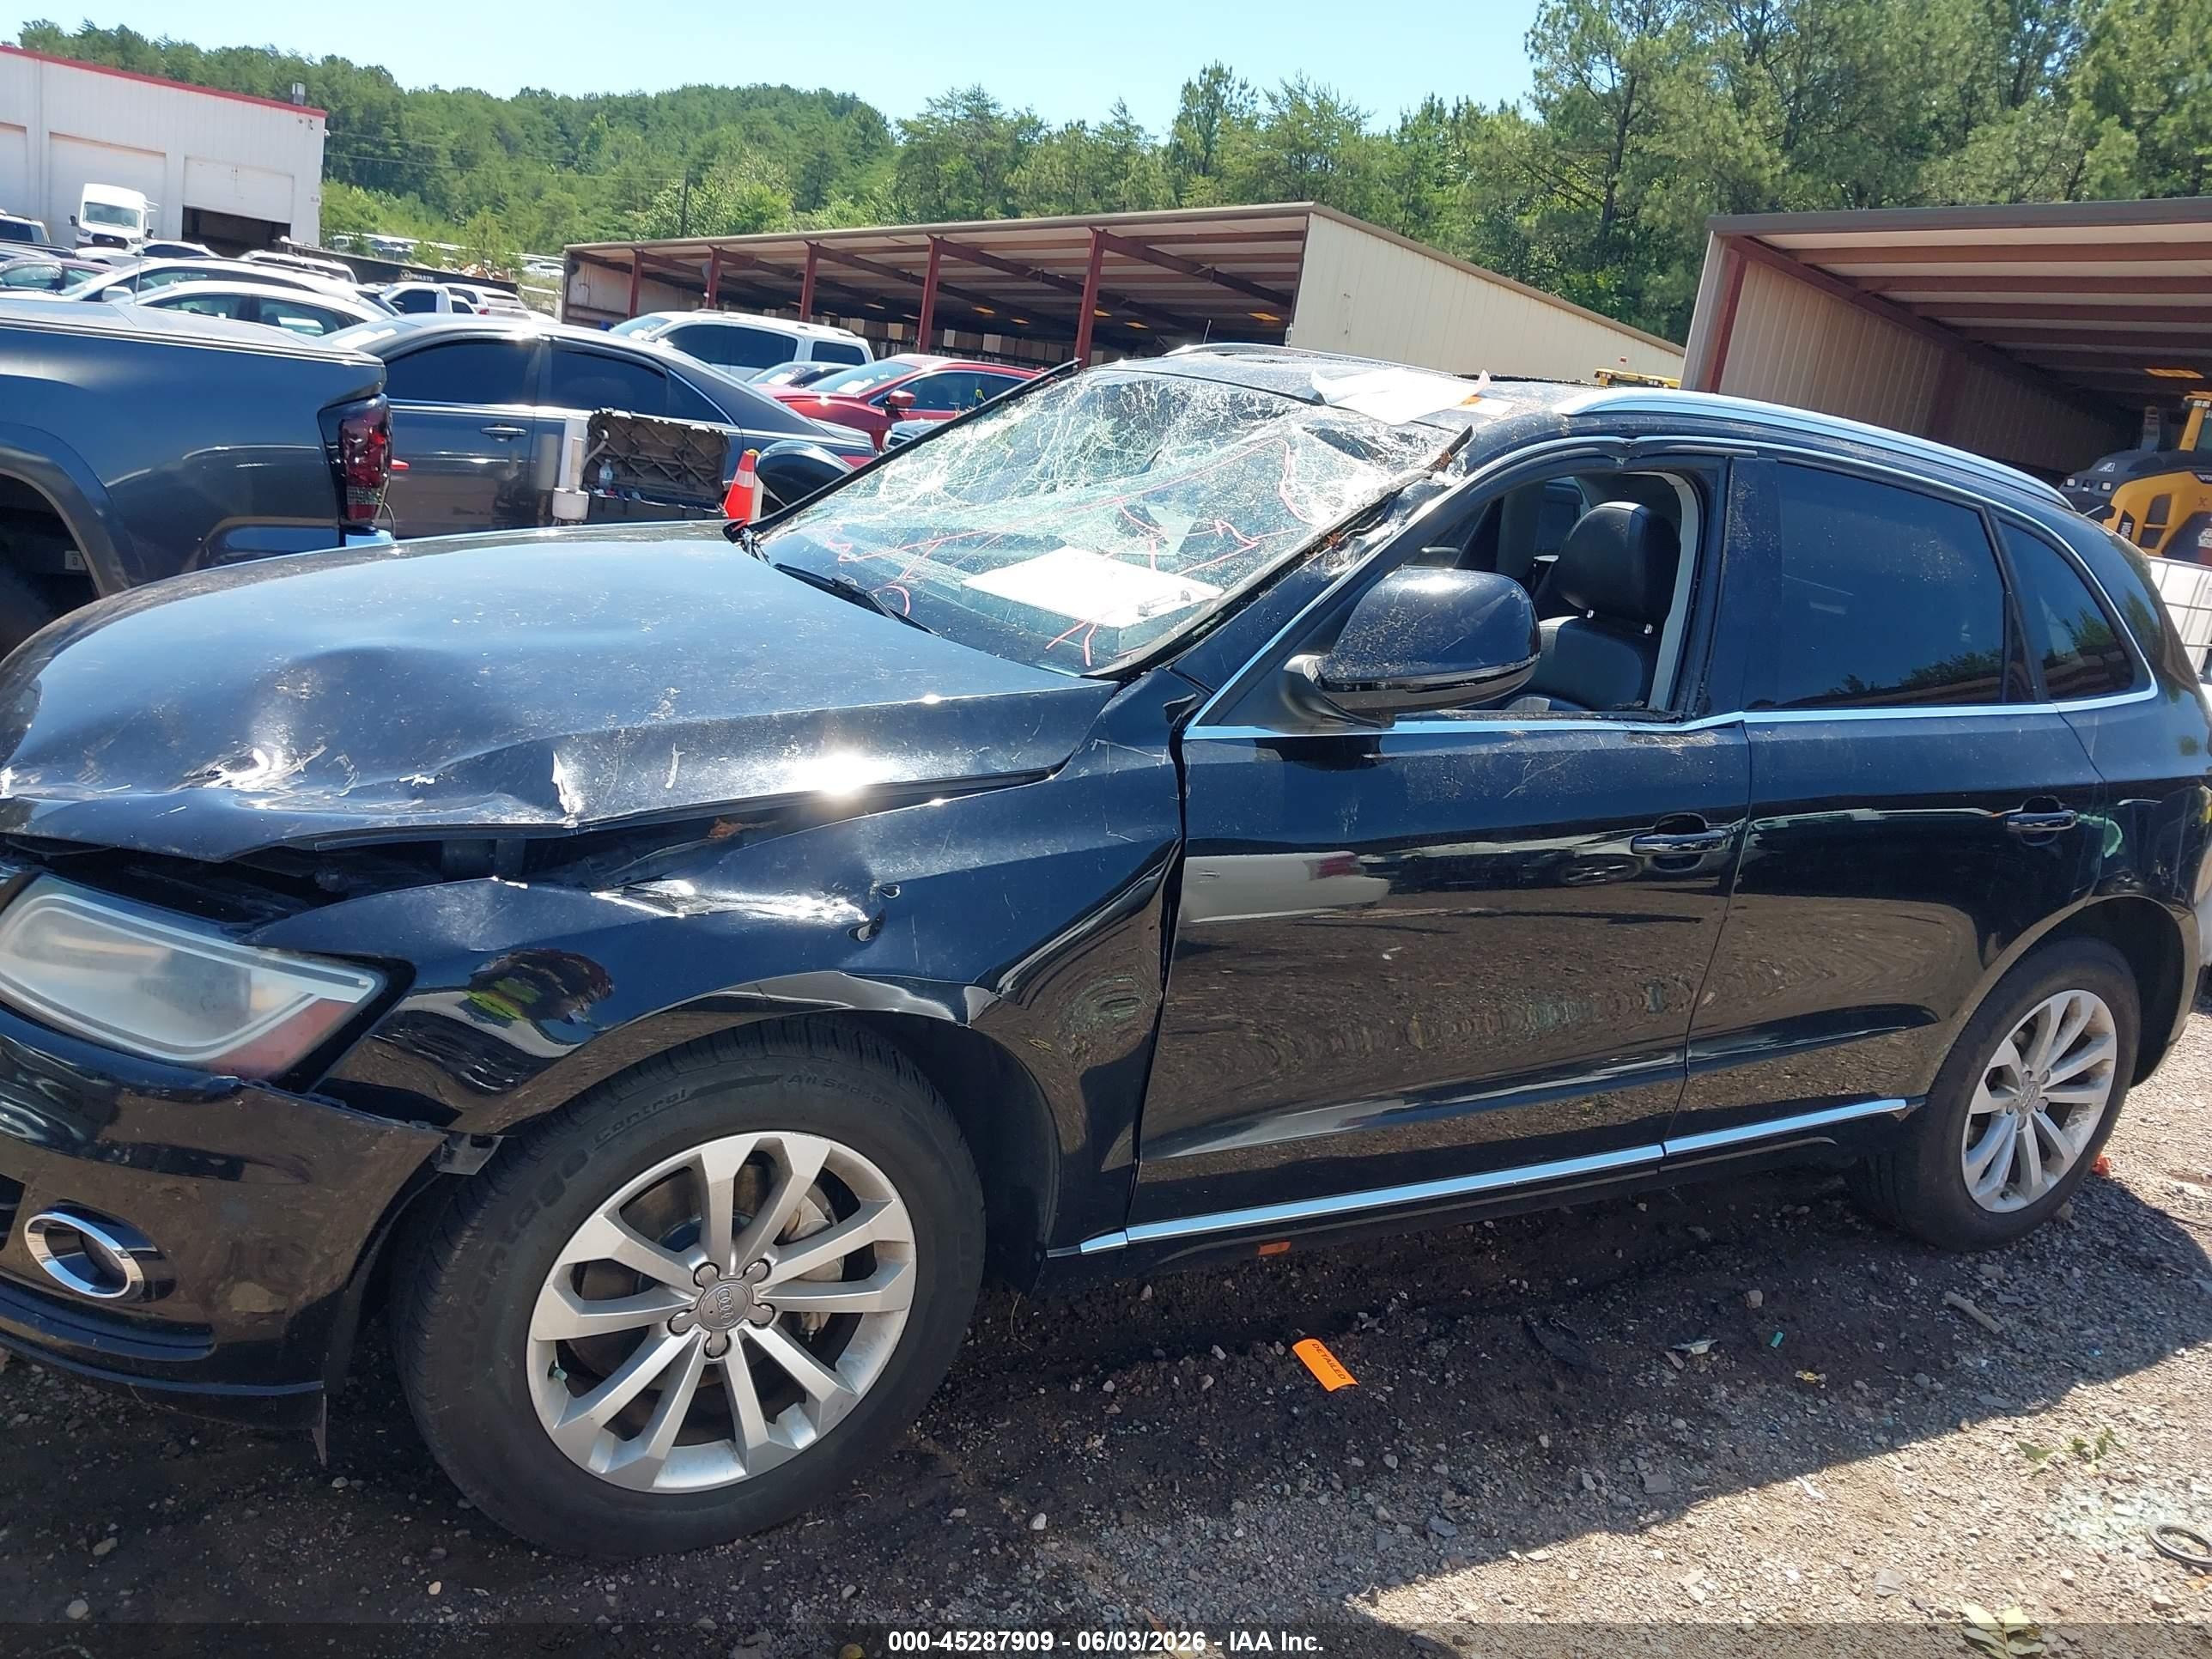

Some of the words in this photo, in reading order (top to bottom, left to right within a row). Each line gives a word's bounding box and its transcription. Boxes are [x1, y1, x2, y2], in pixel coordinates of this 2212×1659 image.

[593, 1088, 689, 1144] Control
[787, 1072, 818, 1086] All
[1311, 1342, 1346, 1380] DETAILED
